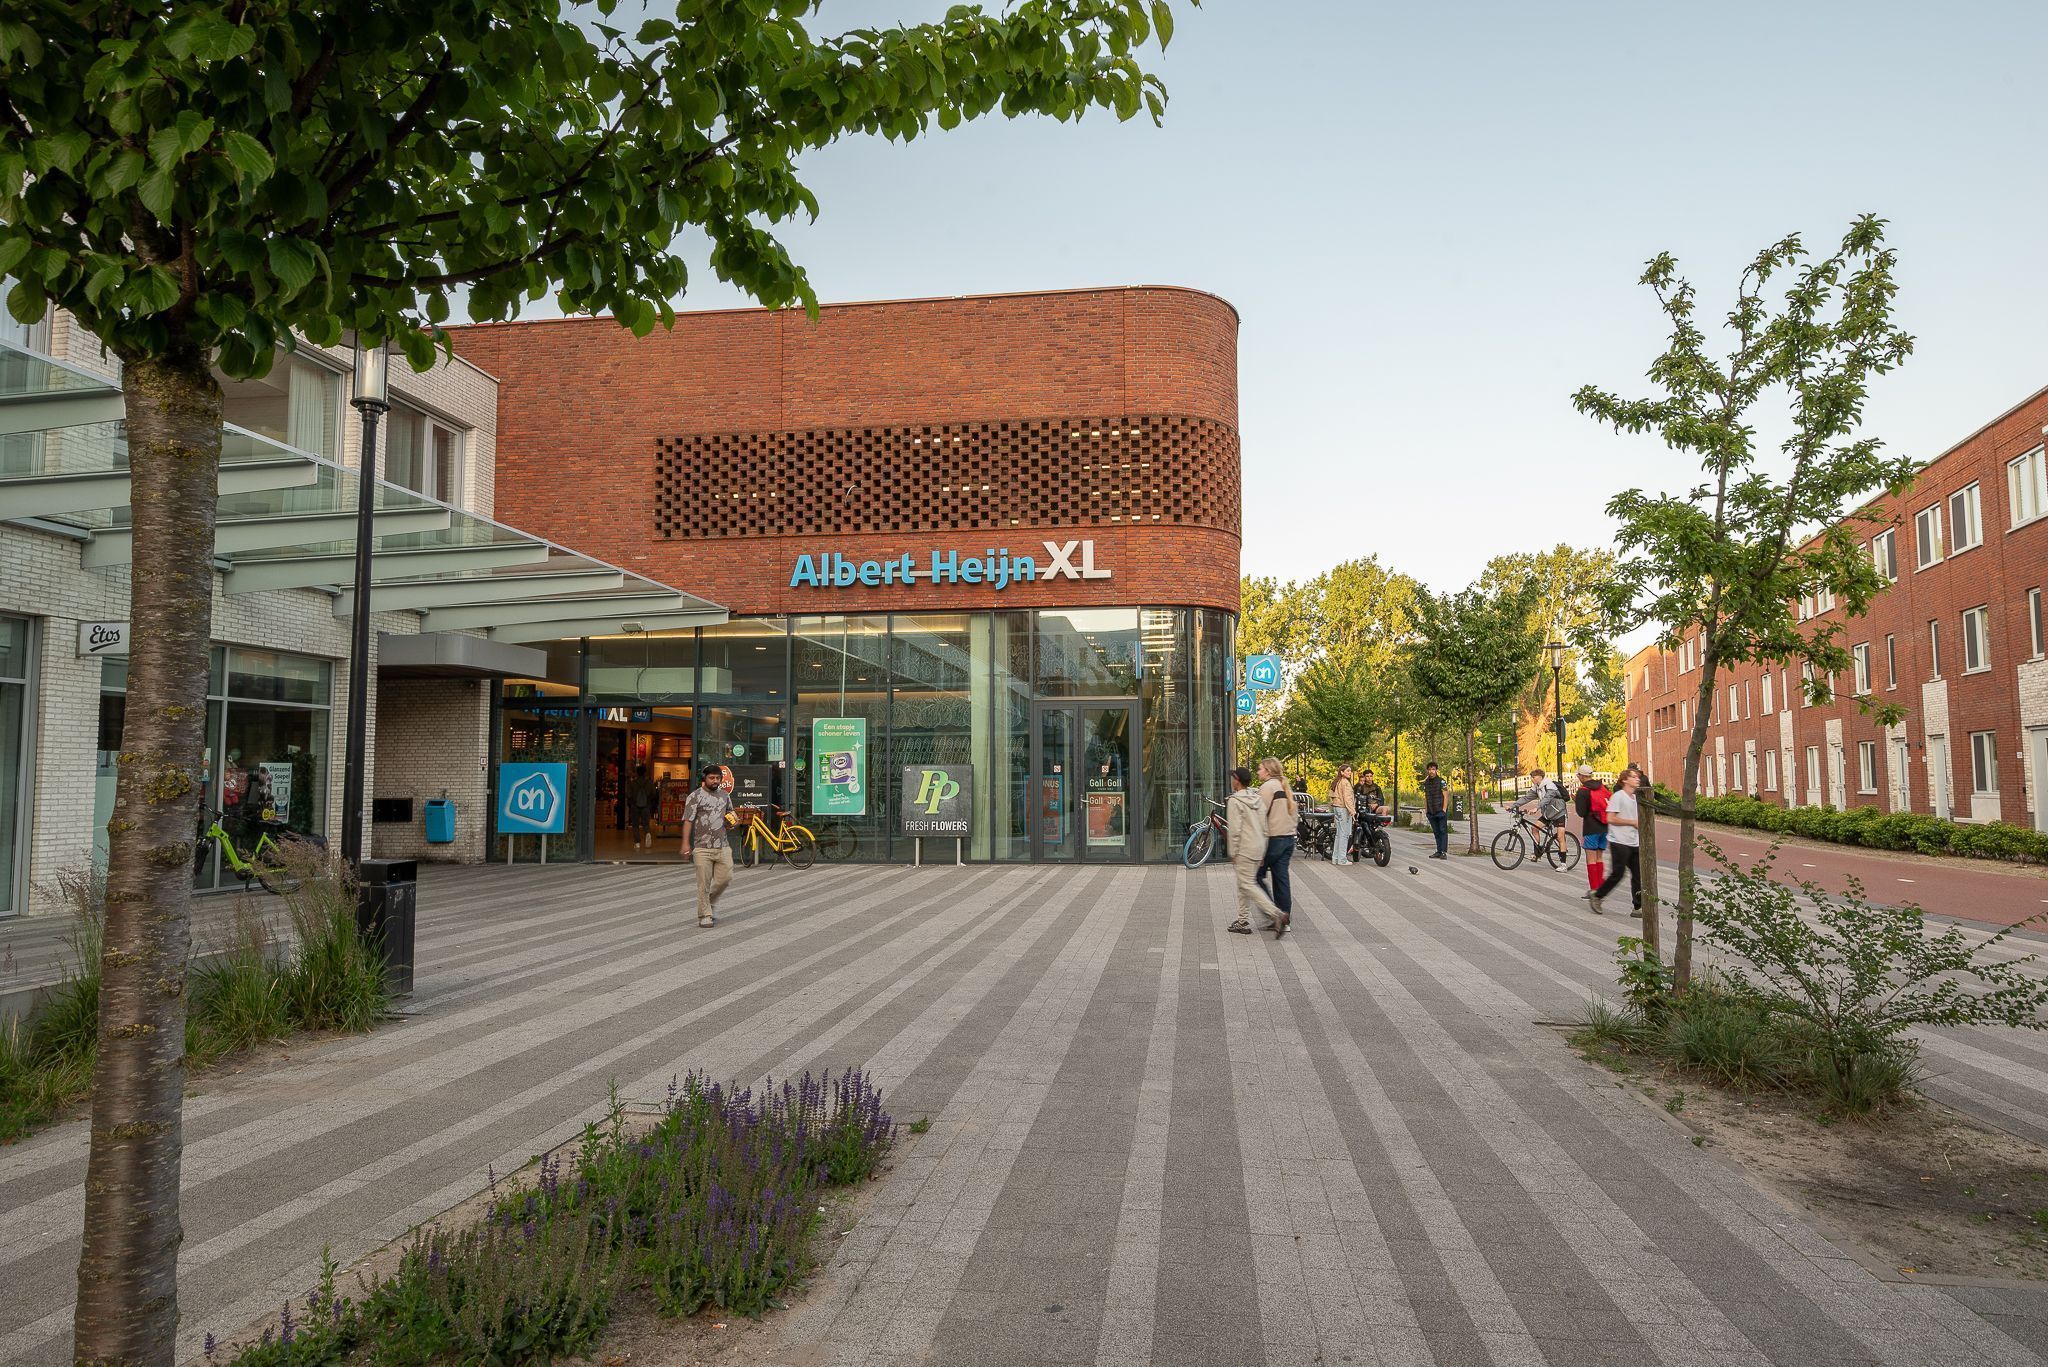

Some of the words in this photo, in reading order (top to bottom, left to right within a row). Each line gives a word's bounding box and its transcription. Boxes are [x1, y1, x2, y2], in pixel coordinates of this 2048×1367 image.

[789, 551, 916, 587] Albert
[931, 547, 1036, 591] Heijn
[1040, 540, 1112, 580] XL
[90, 625, 120, 644] Etos
[1089, 778, 1104, 787] Gall
[1107, 778, 1122, 787] Gall
[1089, 796, 1103, 805] Gall
[905, 821, 929, 831] FRESH
[931, 821, 968, 832] FLOWERS
